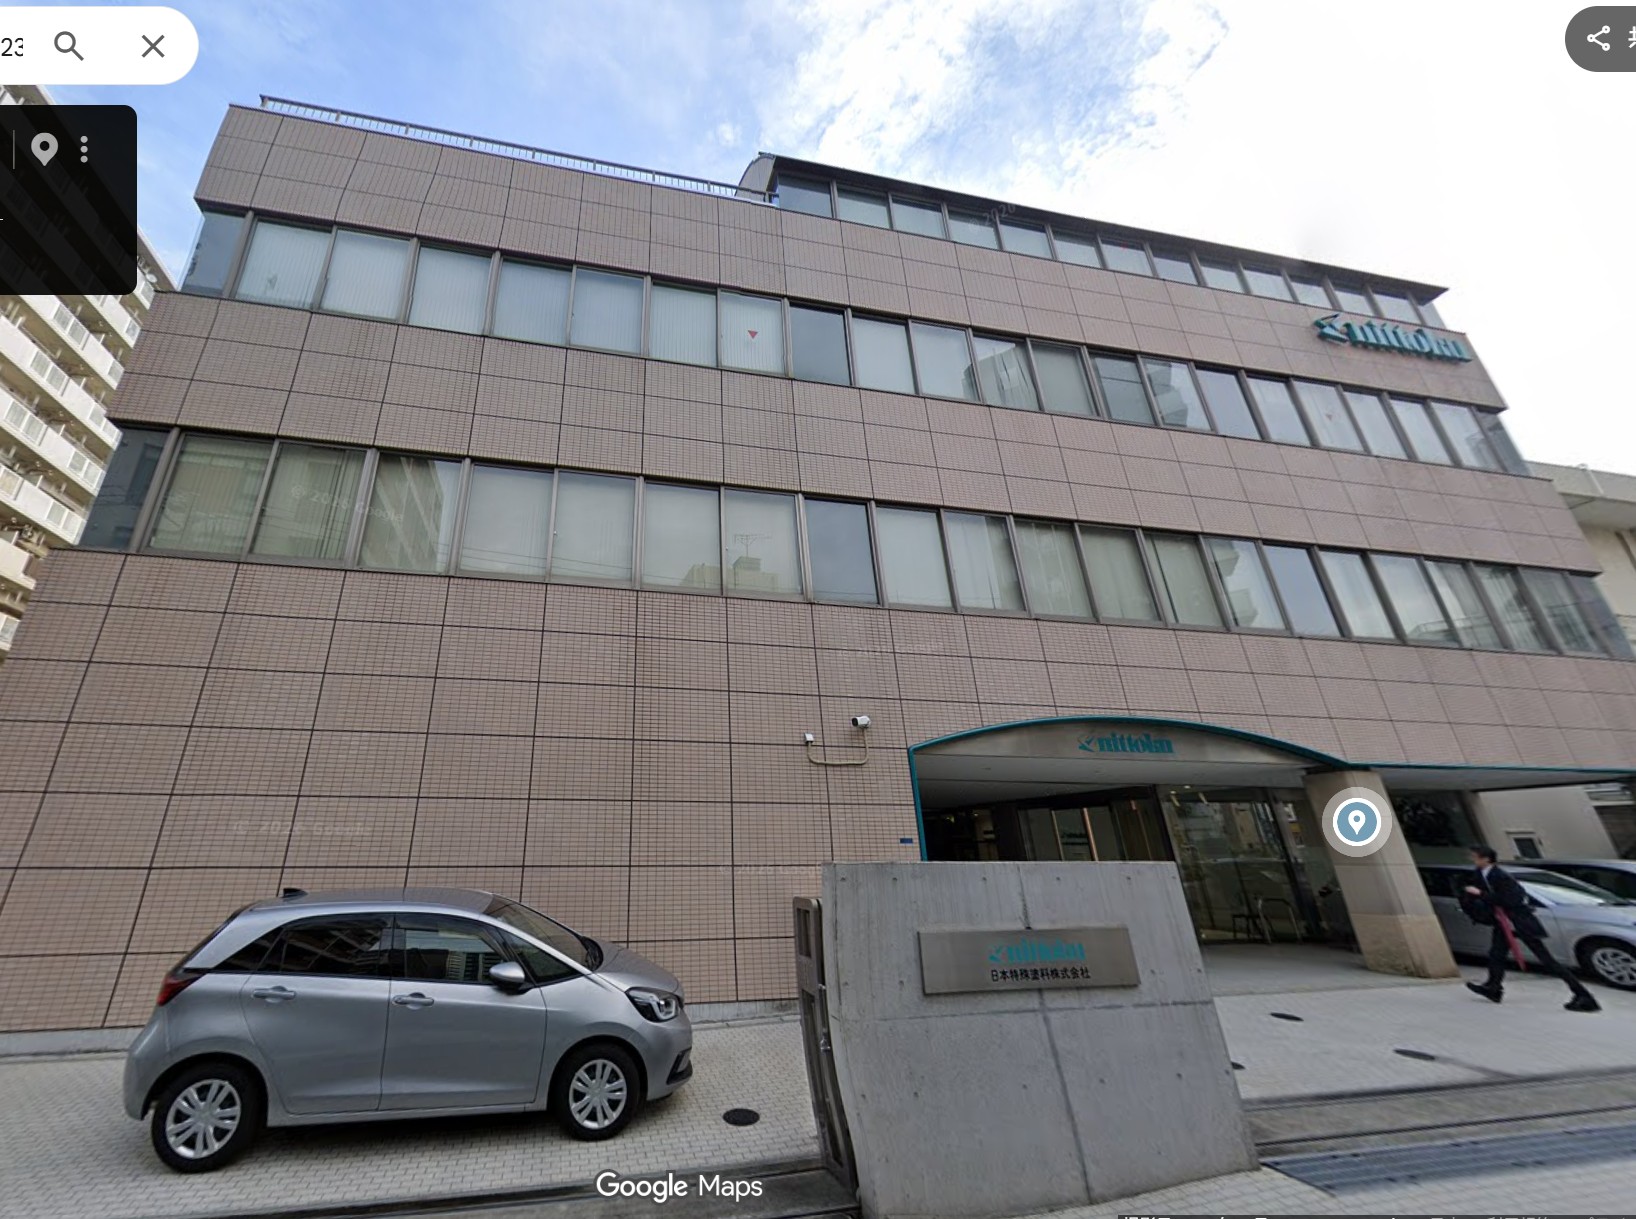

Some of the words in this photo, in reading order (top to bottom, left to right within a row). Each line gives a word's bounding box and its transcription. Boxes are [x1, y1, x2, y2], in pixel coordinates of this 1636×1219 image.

[991, 966, 1091, 983] 日本特殊塗料株式会社
